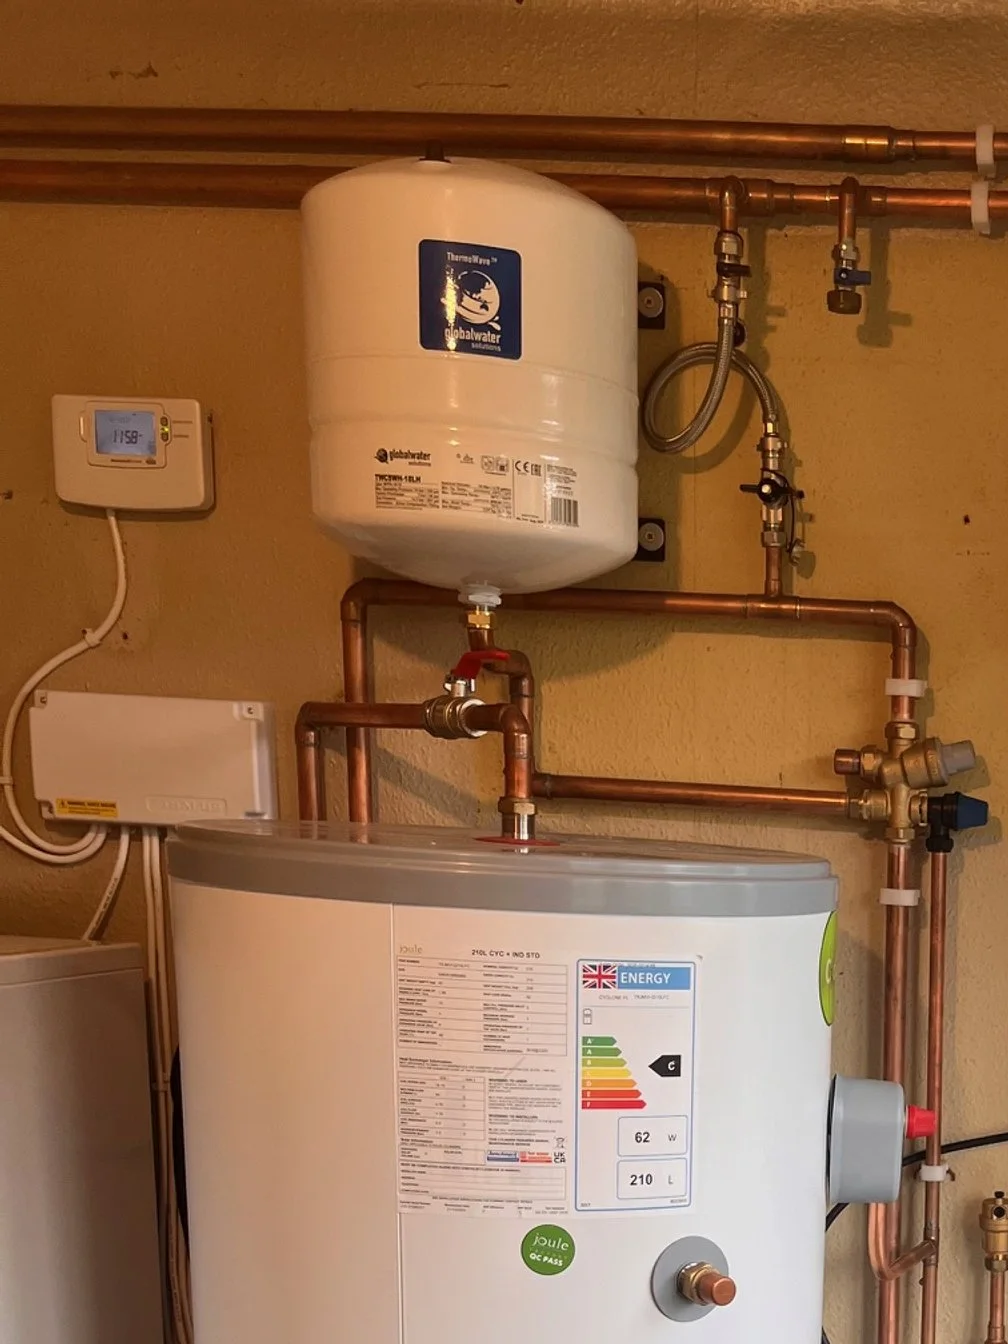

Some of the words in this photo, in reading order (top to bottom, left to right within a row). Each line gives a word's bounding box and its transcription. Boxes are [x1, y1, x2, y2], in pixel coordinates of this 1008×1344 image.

[445, 326, 501, 344] globalwater
[620, 971, 671, 984] ENERGY
[667, 1060, 676, 1071] C
[634, 1131, 650, 1143] 62
[668, 1133, 677, 1142] W
[629, 1173, 653, 1186] 210
[668, 1175, 674, 1185] L
[532, 1232, 570, 1251] joule
[542, 1254, 564, 1267] PASS
